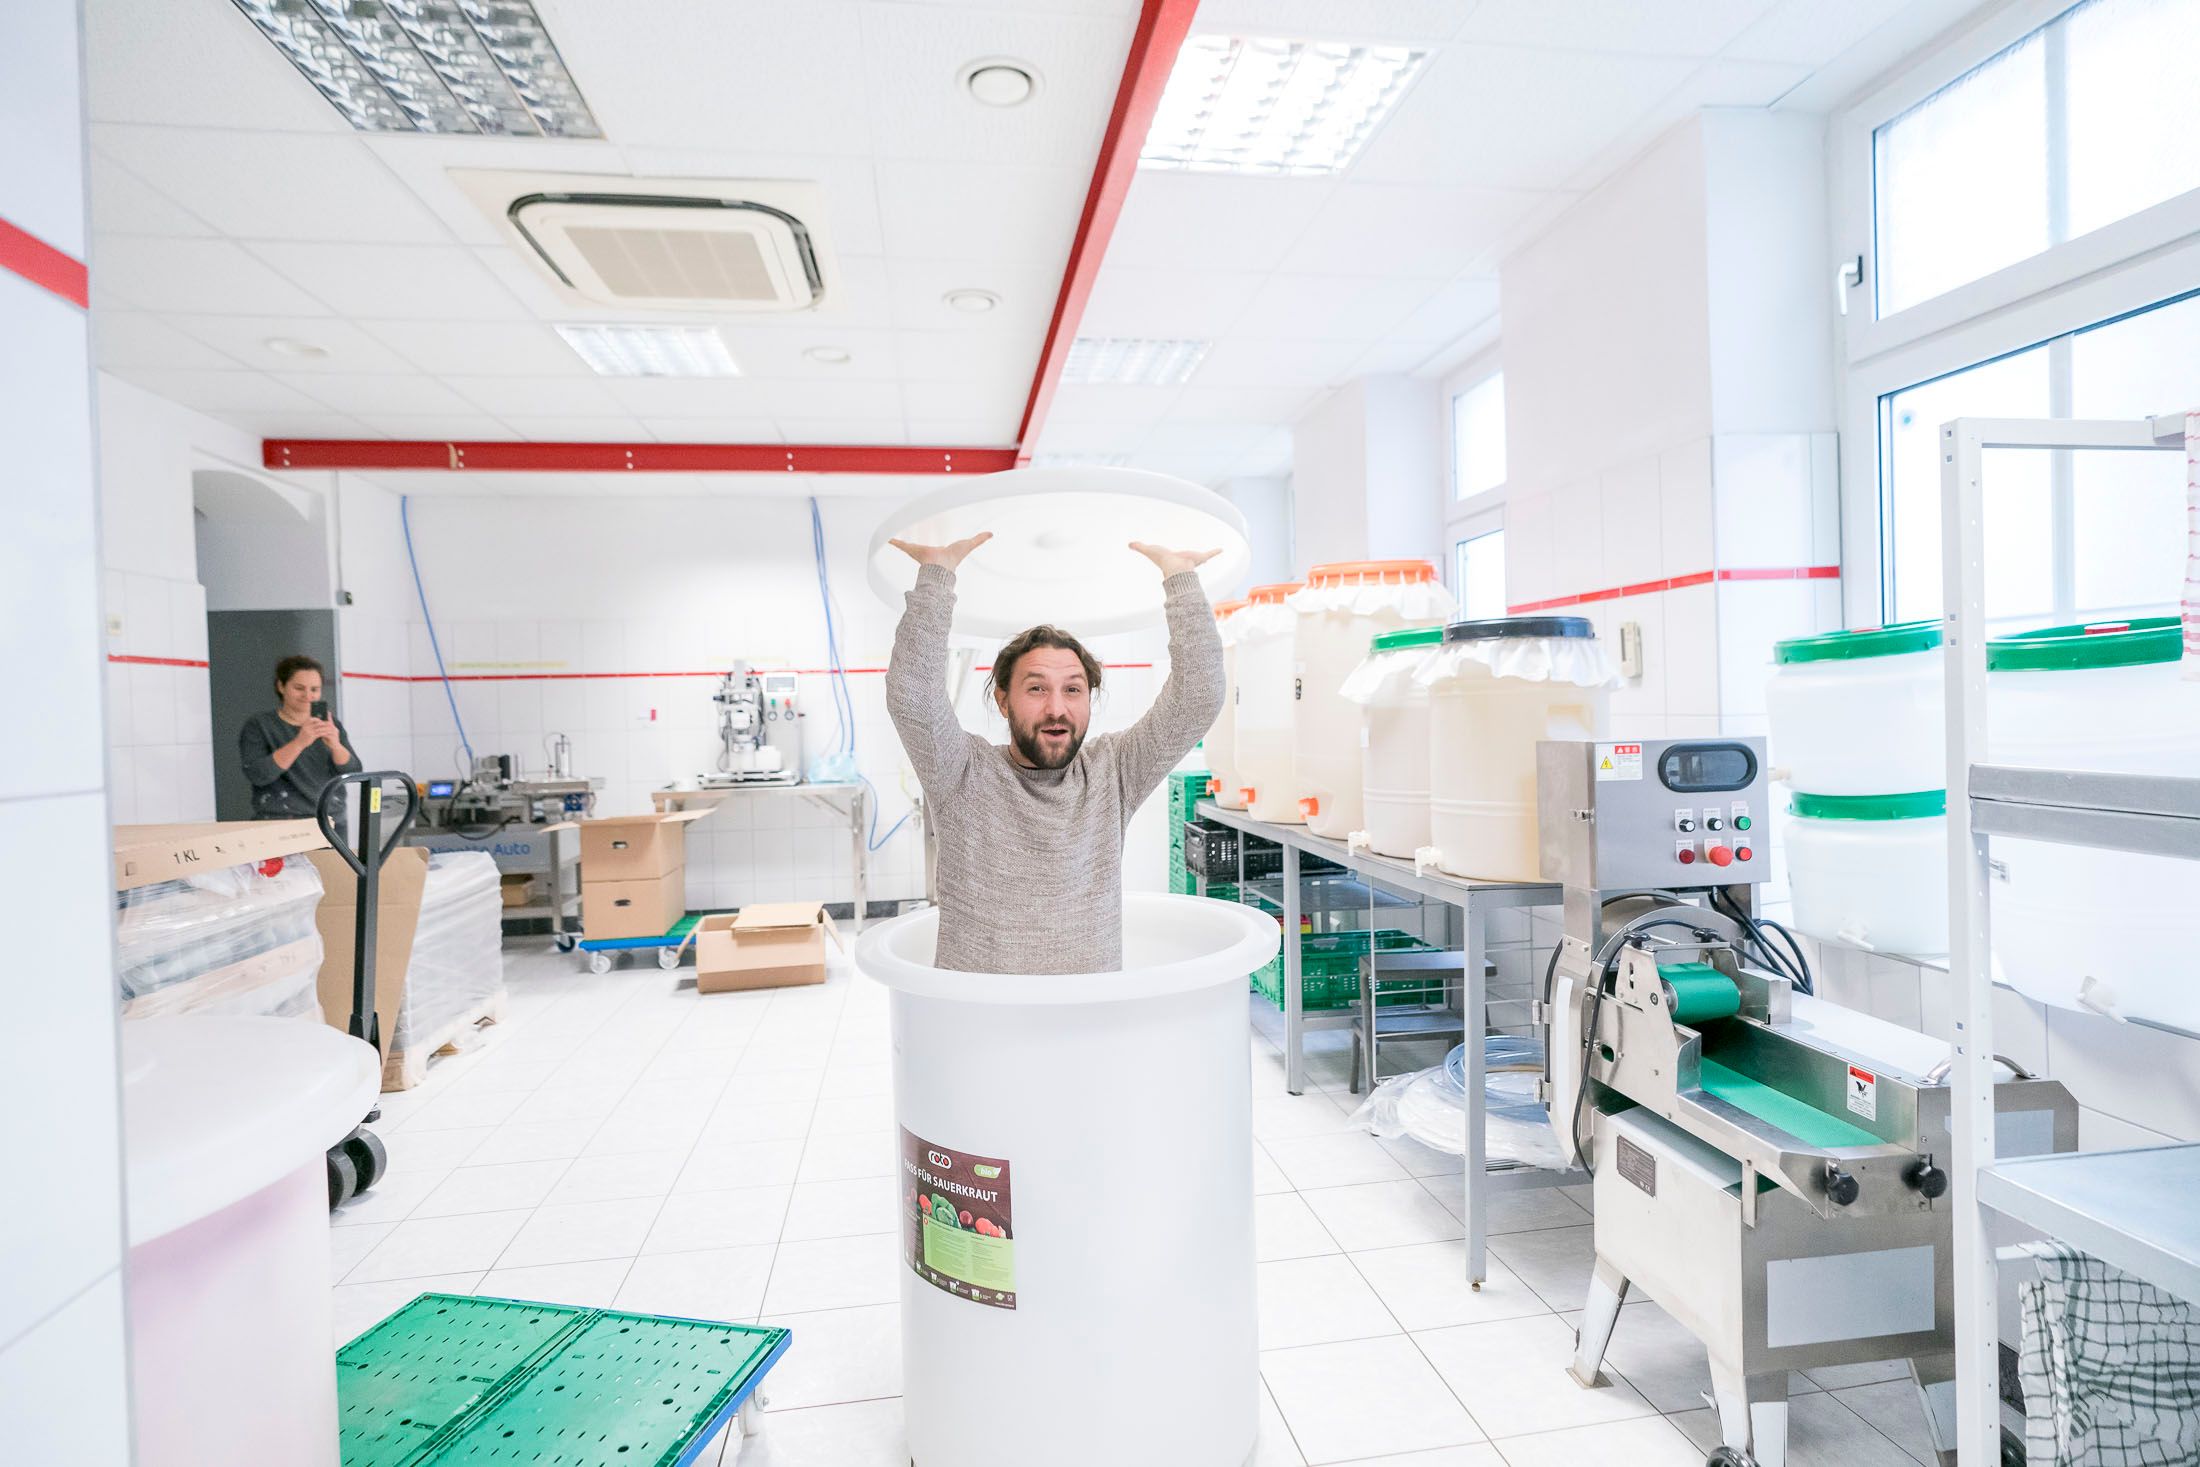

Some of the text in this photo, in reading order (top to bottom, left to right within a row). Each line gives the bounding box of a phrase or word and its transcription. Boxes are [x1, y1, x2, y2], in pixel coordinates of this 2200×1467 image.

[495, 842, 530, 855] Auto
[904, 1159, 998, 1203] FASS FÜR SAUERKRAUT
